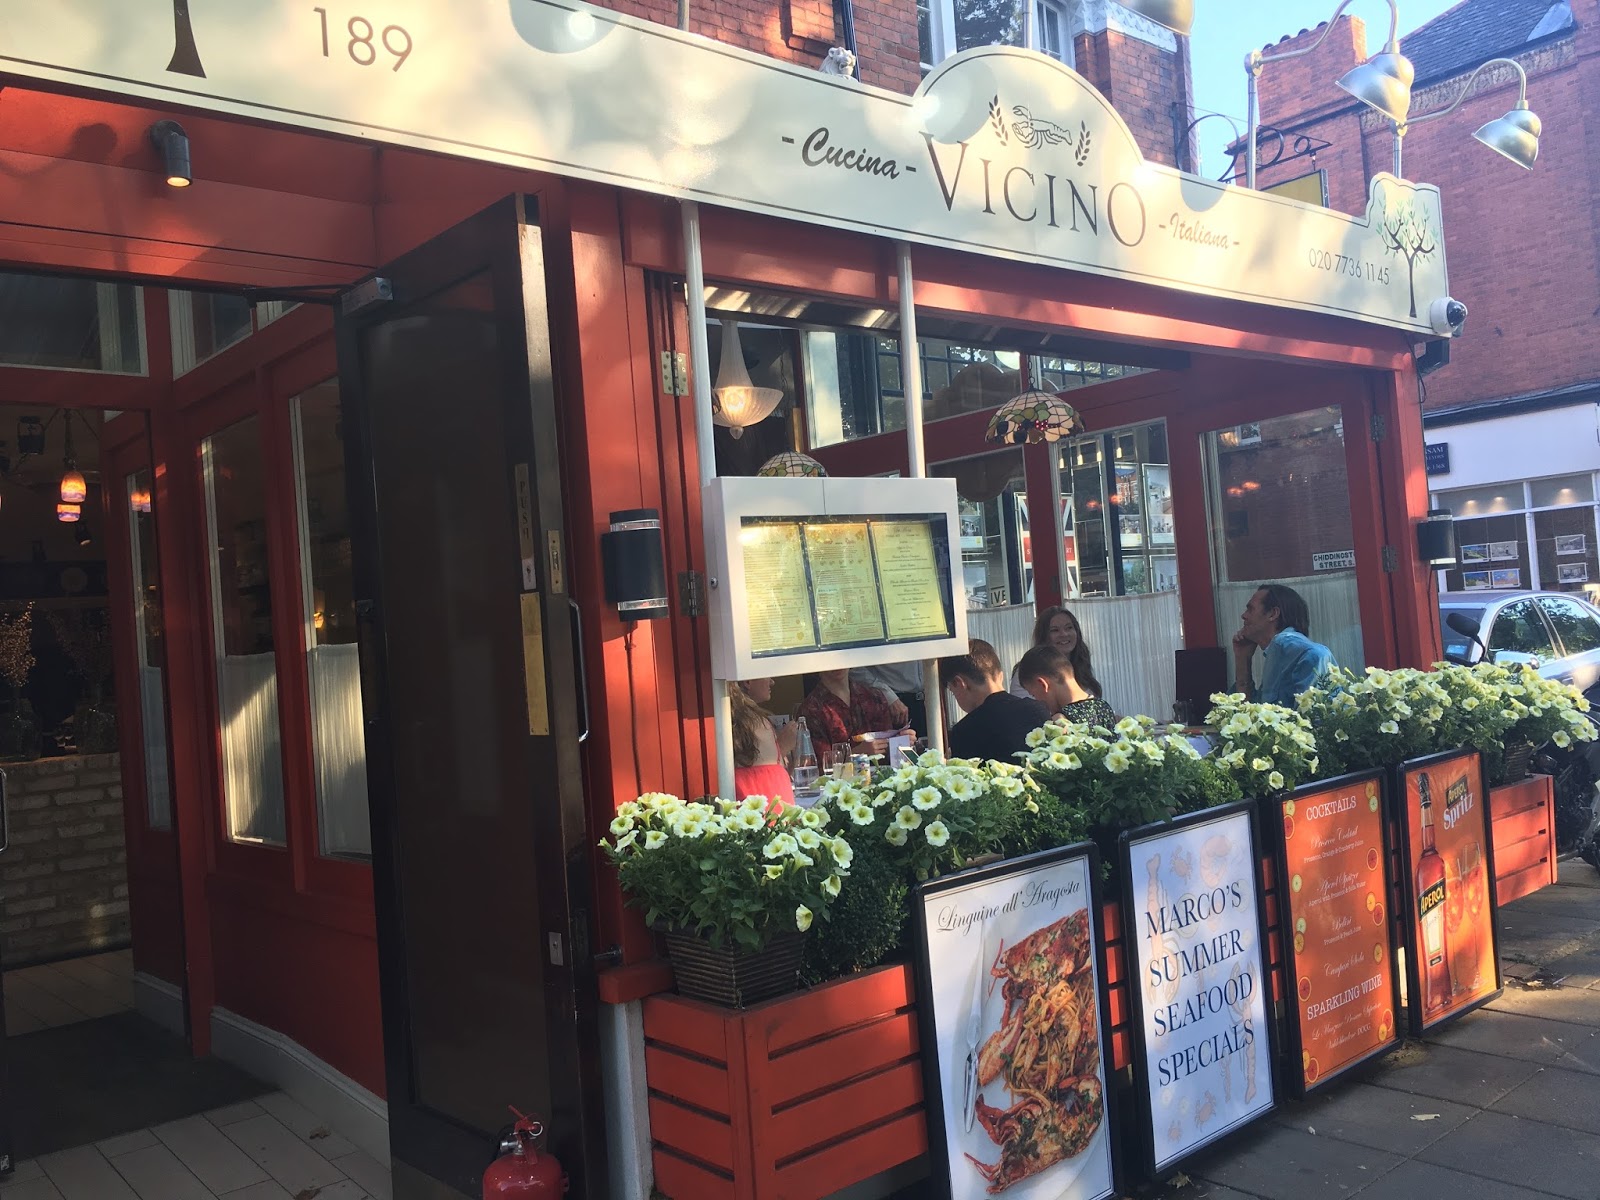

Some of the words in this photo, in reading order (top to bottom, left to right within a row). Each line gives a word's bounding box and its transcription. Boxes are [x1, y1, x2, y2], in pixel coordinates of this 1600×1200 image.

[312, 6, 413, 73] 189
[918, 130, 1146, 247] VICINO
[1308, 247, 1332, 271] 020
[1334, 253, 1362, 279] 7736
[1365, 262, 1390, 286] 1145
[1313, 551, 1354, 562] CHIDDINGST
[1305, 795, 1357, 821] COCKTAILS
[1443, 792, 1474, 830] Spritz
[1447, 781, 1467, 805] APEROL
[936, 904, 999, 937] Linguine
[1021, 879, 1081, 911] Aragosta
[1144, 881, 1242, 940] MARCO'S
[1420, 885, 1445, 916] APEROL
[1149, 928, 1245, 988] SUMMER
[1153, 972, 1253, 1037] SEAFOOD
[1306, 985, 1360, 1021] SPARKLING
[1360, 973, 1383, 995] WINE
[1158, 1018, 1254, 1088] SPECIALS
